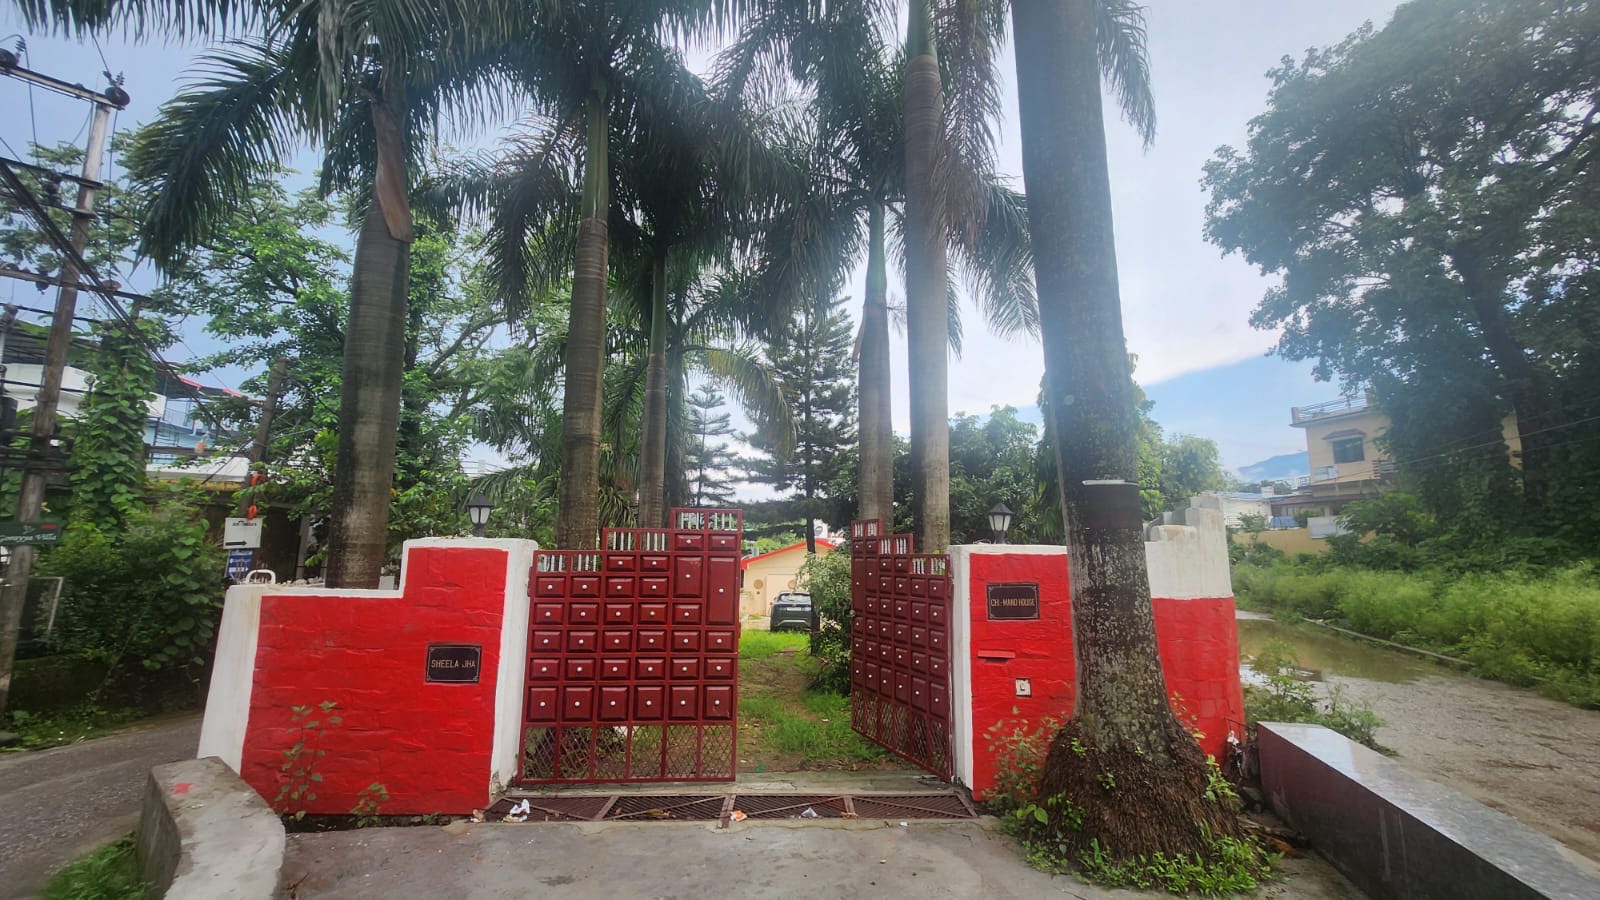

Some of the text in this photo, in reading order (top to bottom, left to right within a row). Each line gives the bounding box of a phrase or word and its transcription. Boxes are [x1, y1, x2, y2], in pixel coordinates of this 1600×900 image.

[1018, 598, 1035, 607] HOUSE
[431, 659, 476, 668] SHEELA JHA
